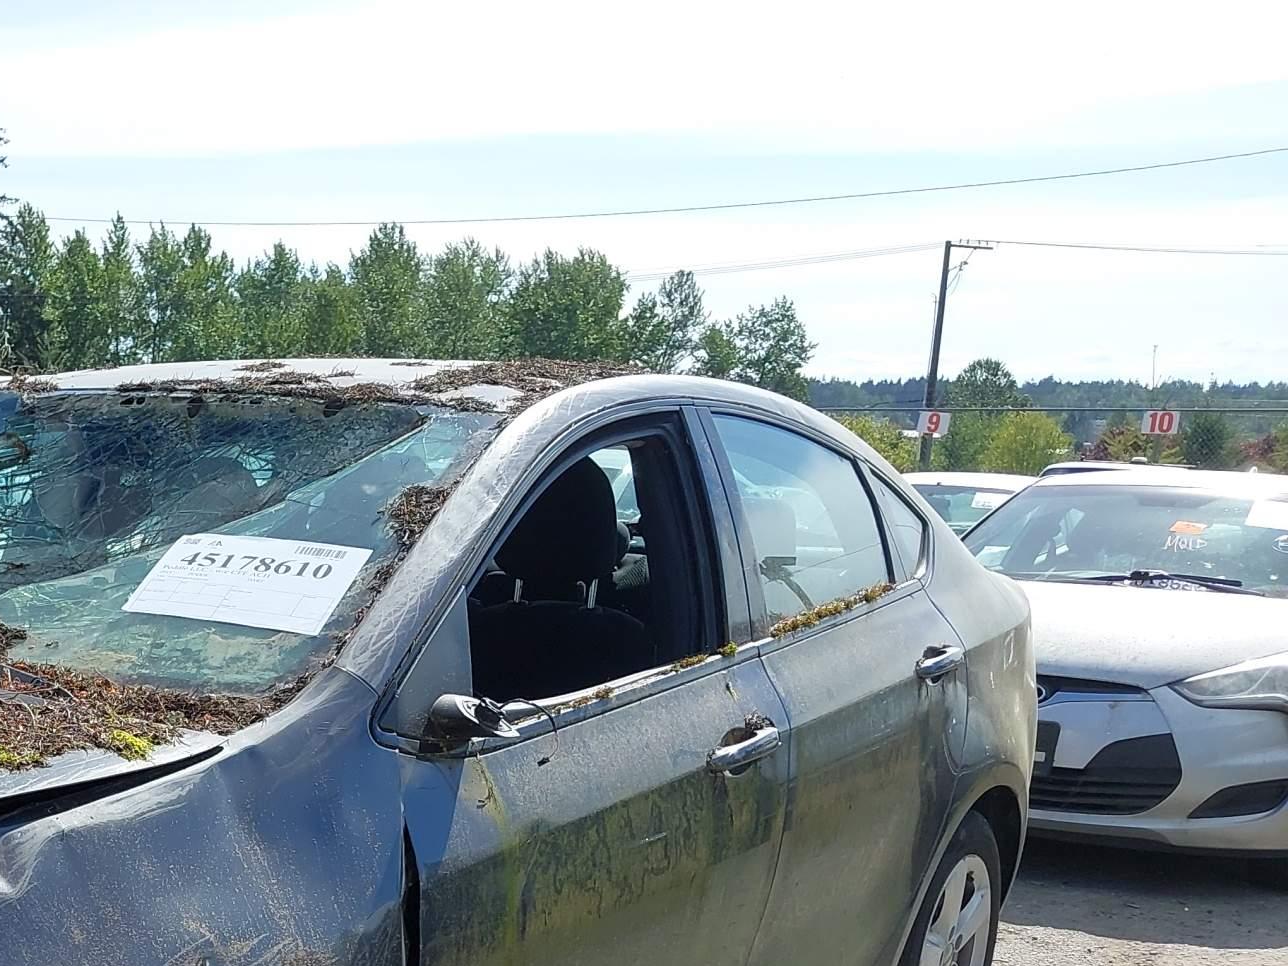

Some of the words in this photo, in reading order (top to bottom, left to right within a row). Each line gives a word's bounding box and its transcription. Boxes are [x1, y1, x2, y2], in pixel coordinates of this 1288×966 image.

[927, 413, 941, 433] 9
[1149, 412, 1174, 433] 10
[1162, 535, 1209, 552] MOLD
[180, 551, 334, 580] 45178610
